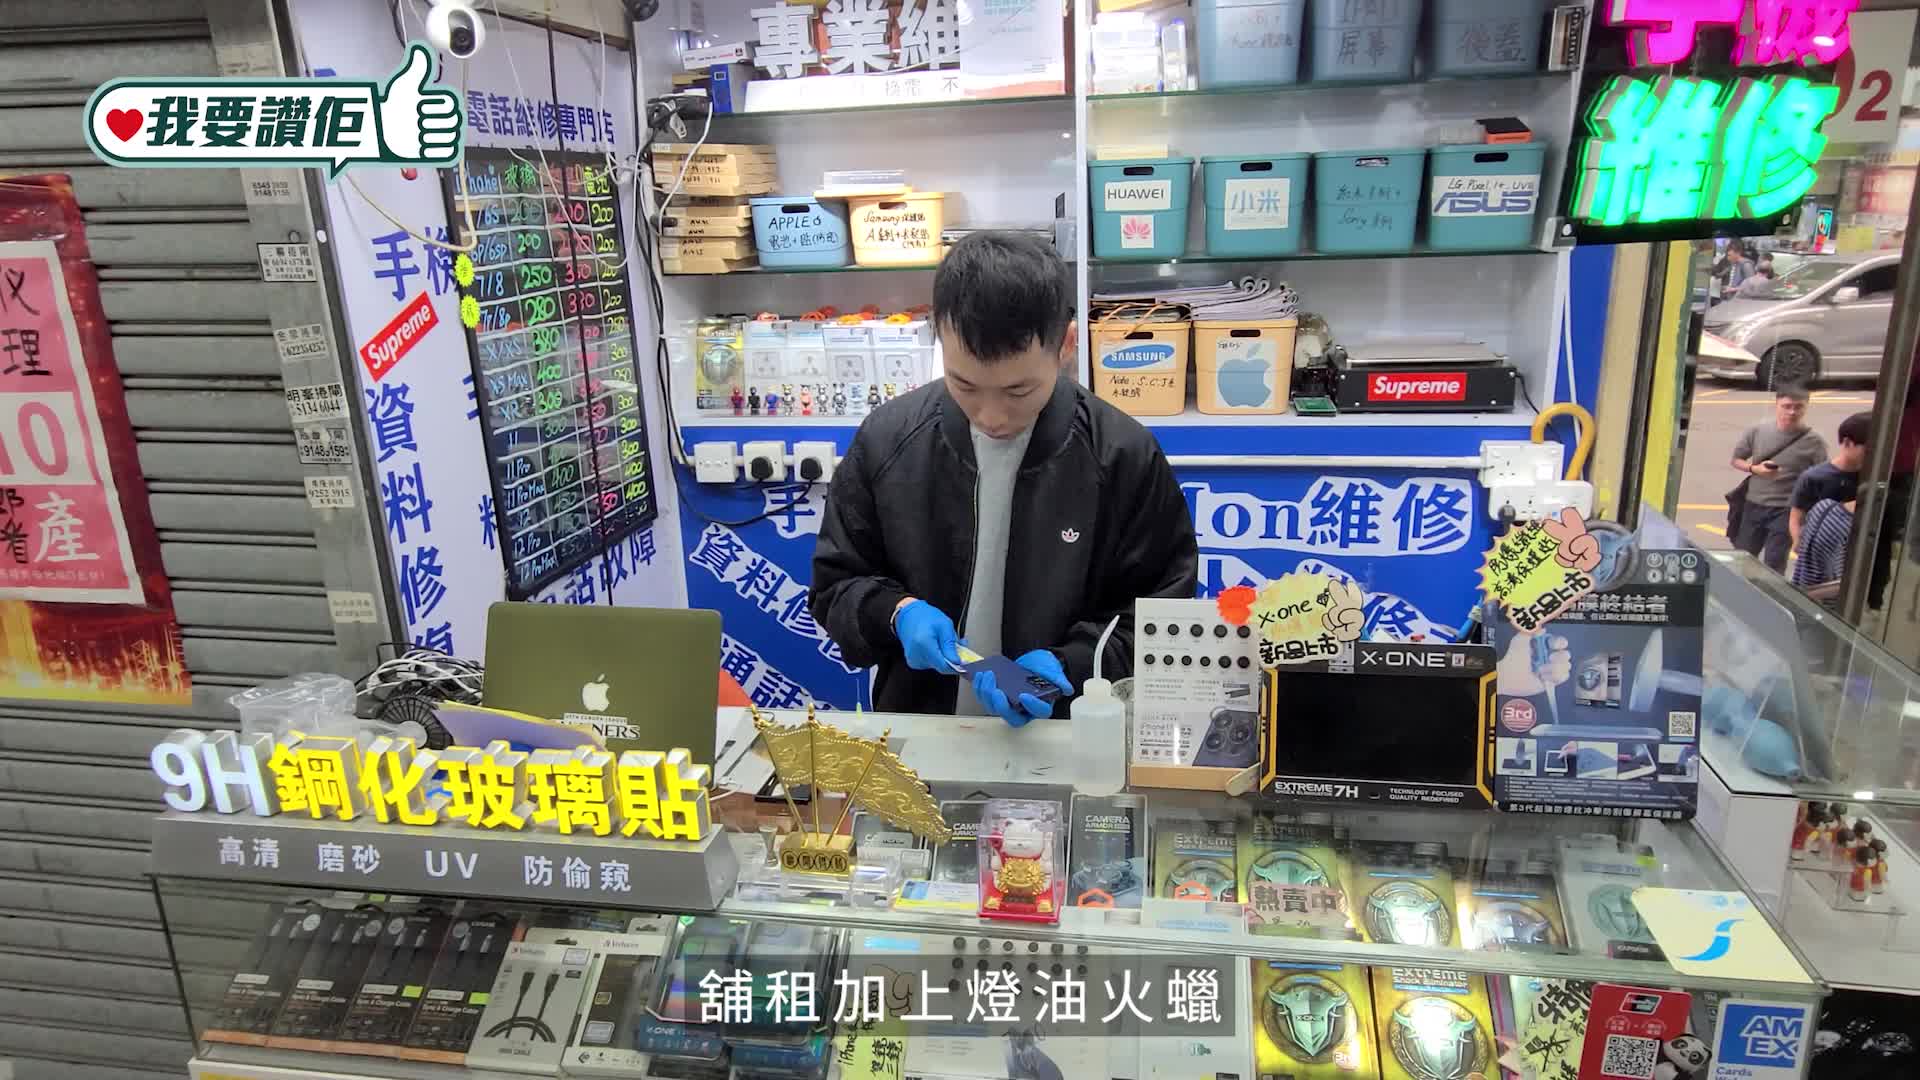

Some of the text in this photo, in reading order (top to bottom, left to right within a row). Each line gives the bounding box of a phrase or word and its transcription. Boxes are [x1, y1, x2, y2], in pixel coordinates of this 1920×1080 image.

[466, 89, 617, 146] 電話維修專門店
[1583, 75, 1842, 226] 維修
[1106, 186, 1165, 201] HUAWEI
[1231, 187, 1281, 216] 小米
[1433, 191, 1535, 214] ASUS
[591, 203, 614, 225] 200
[768, 215, 809, 230] APPLE
[517, 231, 542, 256] 200
[596, 232, 615, 253] 200
[476, 270, 505, 298] 7/8
[520, 264, 553, 290] 250
[603, 288, 622, 310] 200
[525, 296, 557, 326] 280
[366, 300, 432, 372] Supreme
[2, 328, 53, 377] 理
[1110, 351, 1166, 362] SAMSUNG
[1373, 375, 1461, 396] Supreme
[620, 416, 638, 434] 300
[621, 439, 639, 460] 300
[624, 460, 643, 477] 400
[625, 481, 647, 500] 400
[33, 490, 101, 563] 產
[1511, 569, 1592, 630] 新品上市
[1259, 633, 1338, 665] 新品上市
[1504, 707, 1533, 720] 3rd
[1275, 781, 1359, 799] EXTREME 7H
[1420, 796, 1460, 804] REDEFINED
[1431, 790, 1465, 798] FOCUSED
[1084, 814, 1130, 824] CAMERA
[218, 836, 633, 893] 高清 磨砂 UV 防偷窺
[1392, 977, 1421, 986] Shock
[1740, 1015, 1804, 1039] AM
[1746, 1036, 1799, 1060] EX
[1716, 1066, 1752, 1077] Cards
